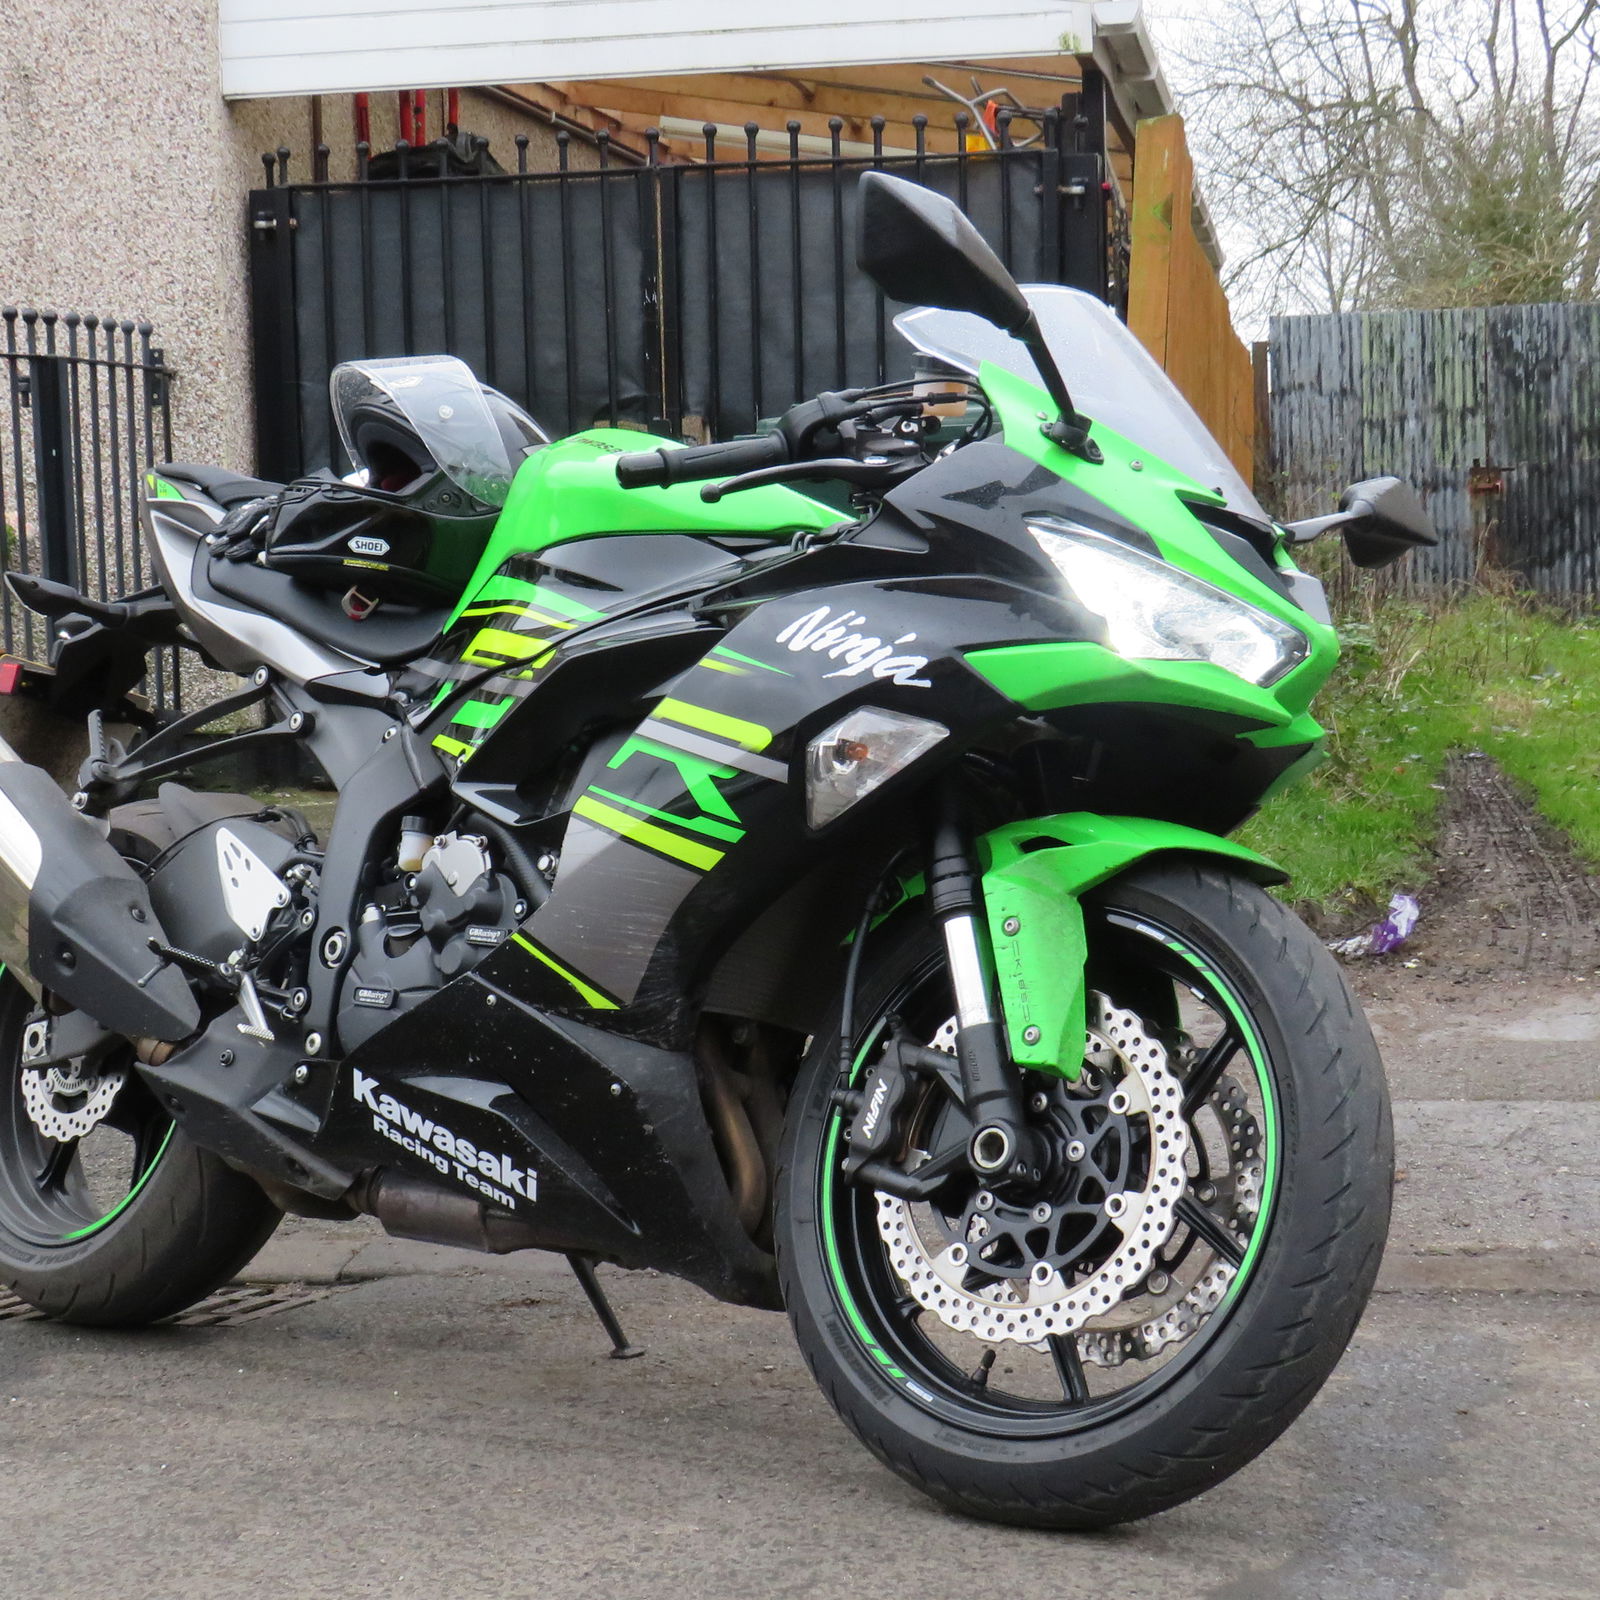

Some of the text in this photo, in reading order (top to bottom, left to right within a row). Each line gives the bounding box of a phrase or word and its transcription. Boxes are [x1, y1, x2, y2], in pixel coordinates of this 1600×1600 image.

[354, 540, 384, 552] SHOEI
[776, 605, 932, 688] Ninja
[352, 1067, 538, 1203] Kawasaki
[373, 1114, 516, 1210] Racing Team
